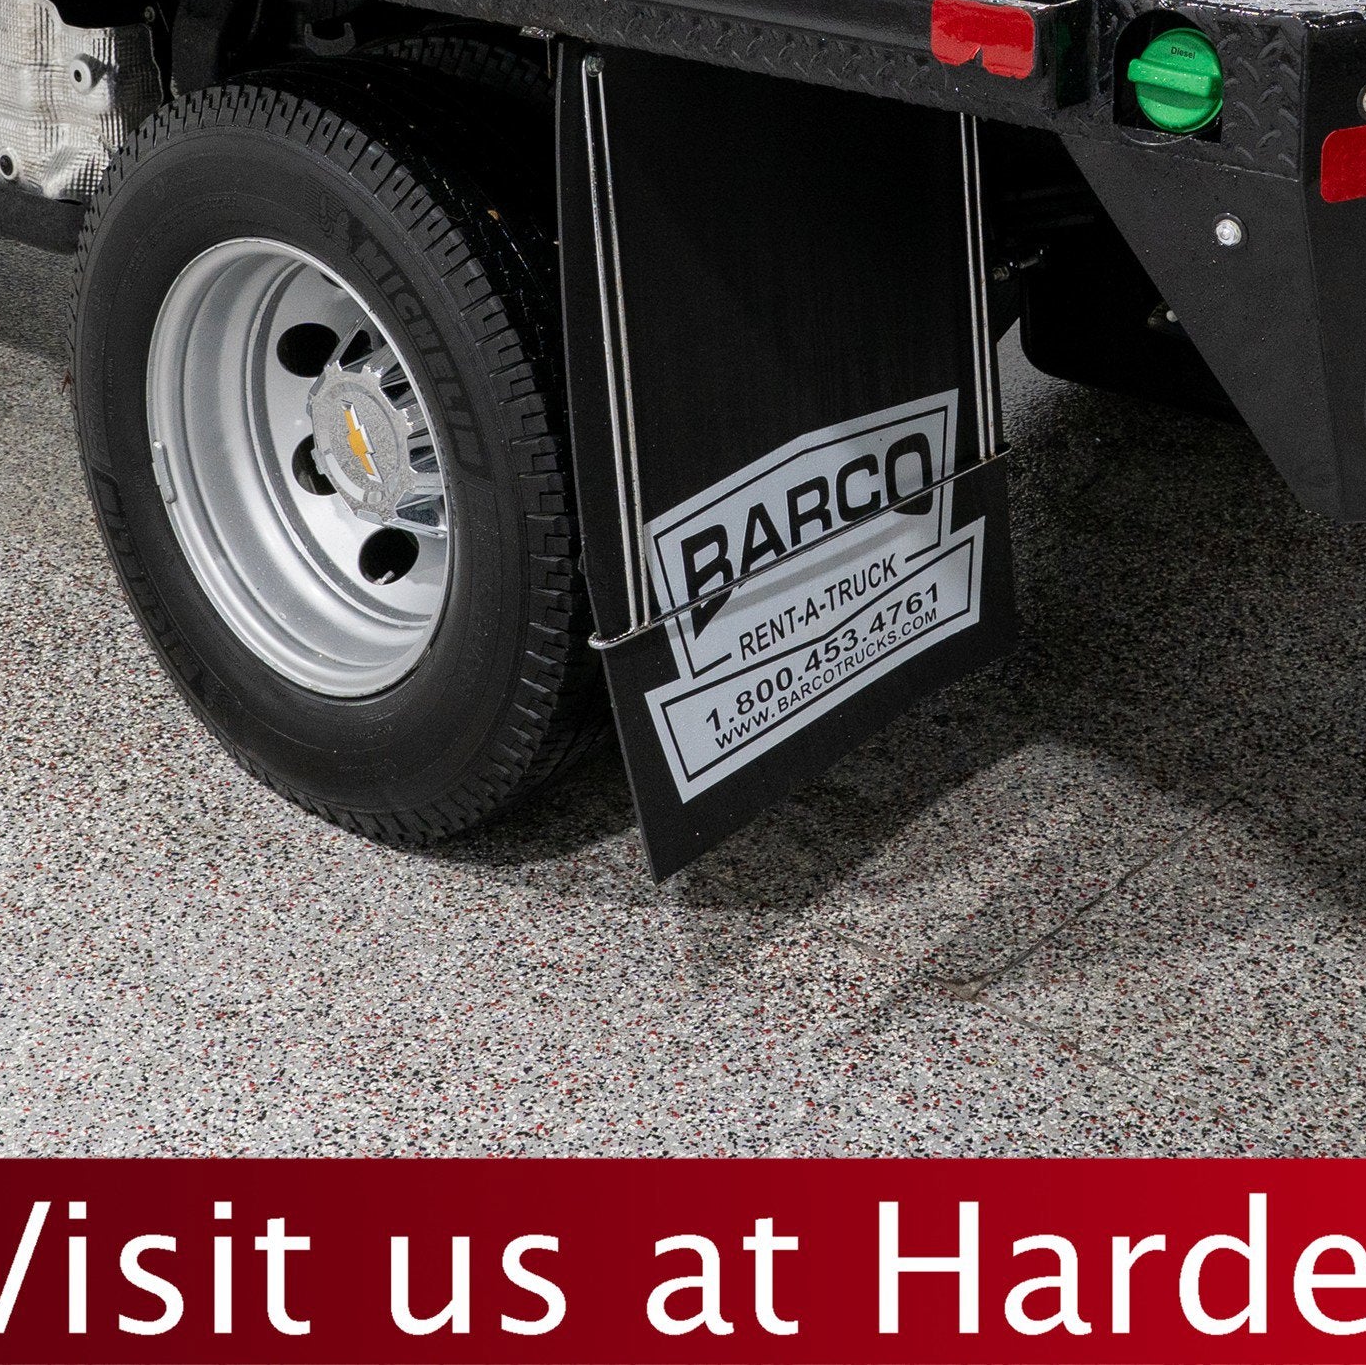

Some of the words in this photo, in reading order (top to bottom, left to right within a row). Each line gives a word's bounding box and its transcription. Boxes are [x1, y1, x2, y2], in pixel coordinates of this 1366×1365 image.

[1170, 46, 1196, 60] Diesel
[680, 432, 934, 641] BARCO
[738, 553, 899, 662] RENT-A-TRUCK
[705, 581, 939, 733] 1.800.453.4761
[714, 607, 938, 750] WWW.BARCOTRUCKS.COM
